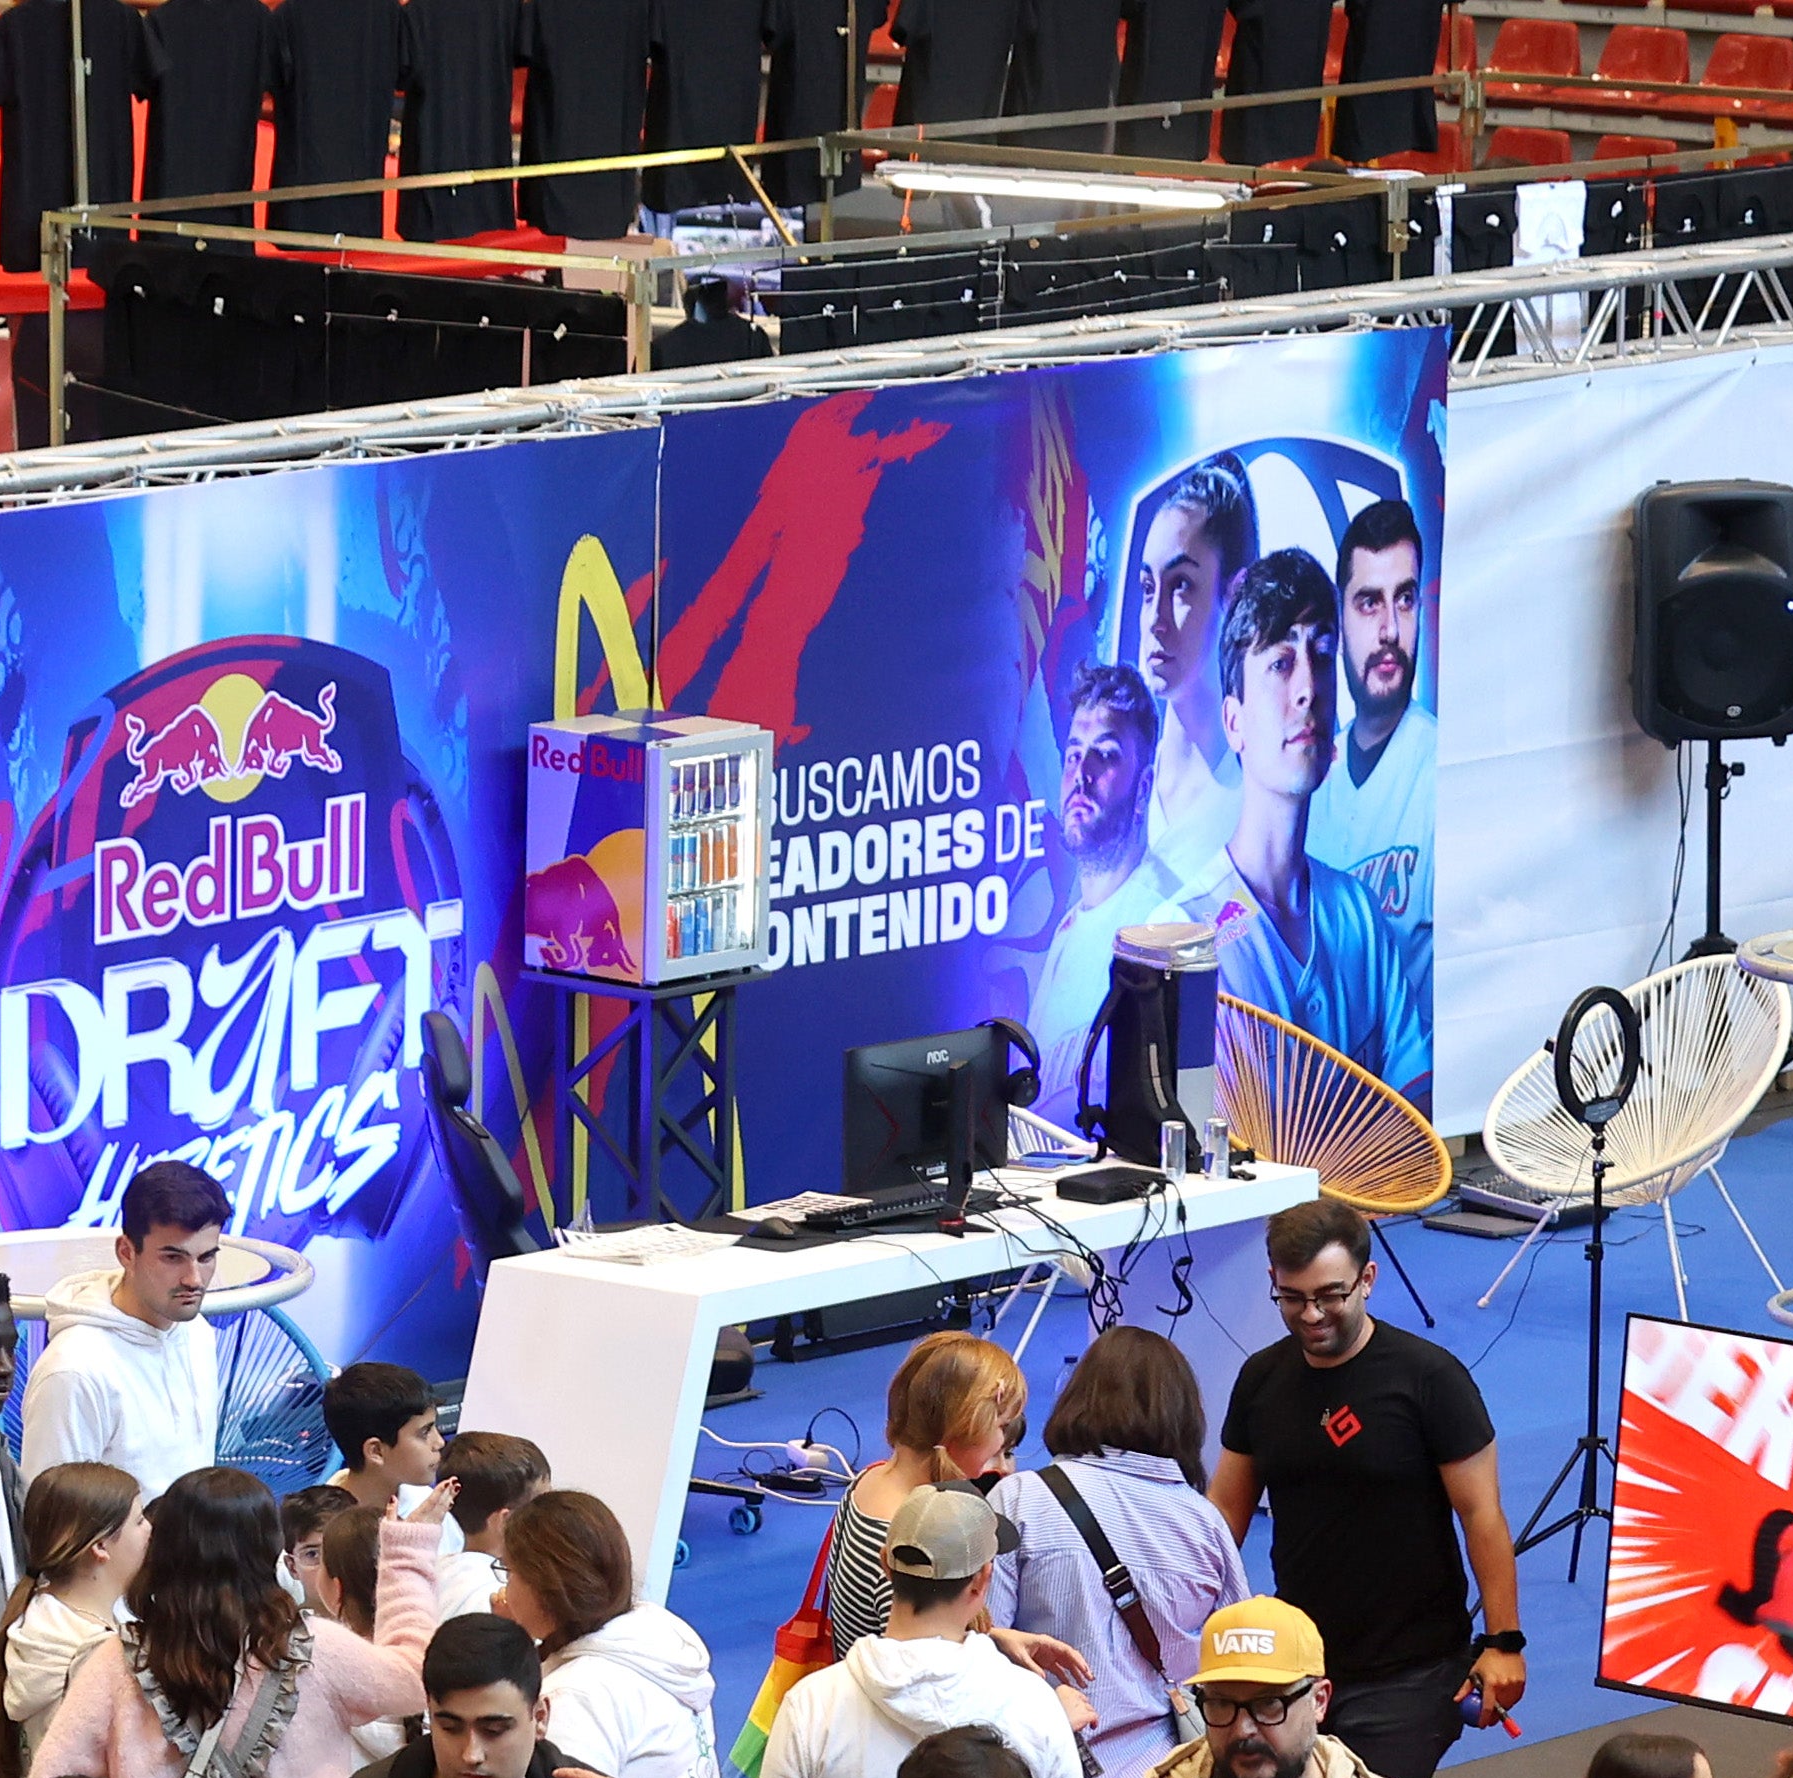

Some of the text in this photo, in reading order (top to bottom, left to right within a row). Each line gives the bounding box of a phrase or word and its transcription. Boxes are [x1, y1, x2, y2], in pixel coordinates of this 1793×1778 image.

[532, 734, 643, 782] Red Bull
[94, 792, 367, 945] Red Bull
[768, 799, 1046, 899] EADORES DE
[758, 875, 1008, 970] ONTENIDO
[1213, 1628, 1276, 1656] VANS
